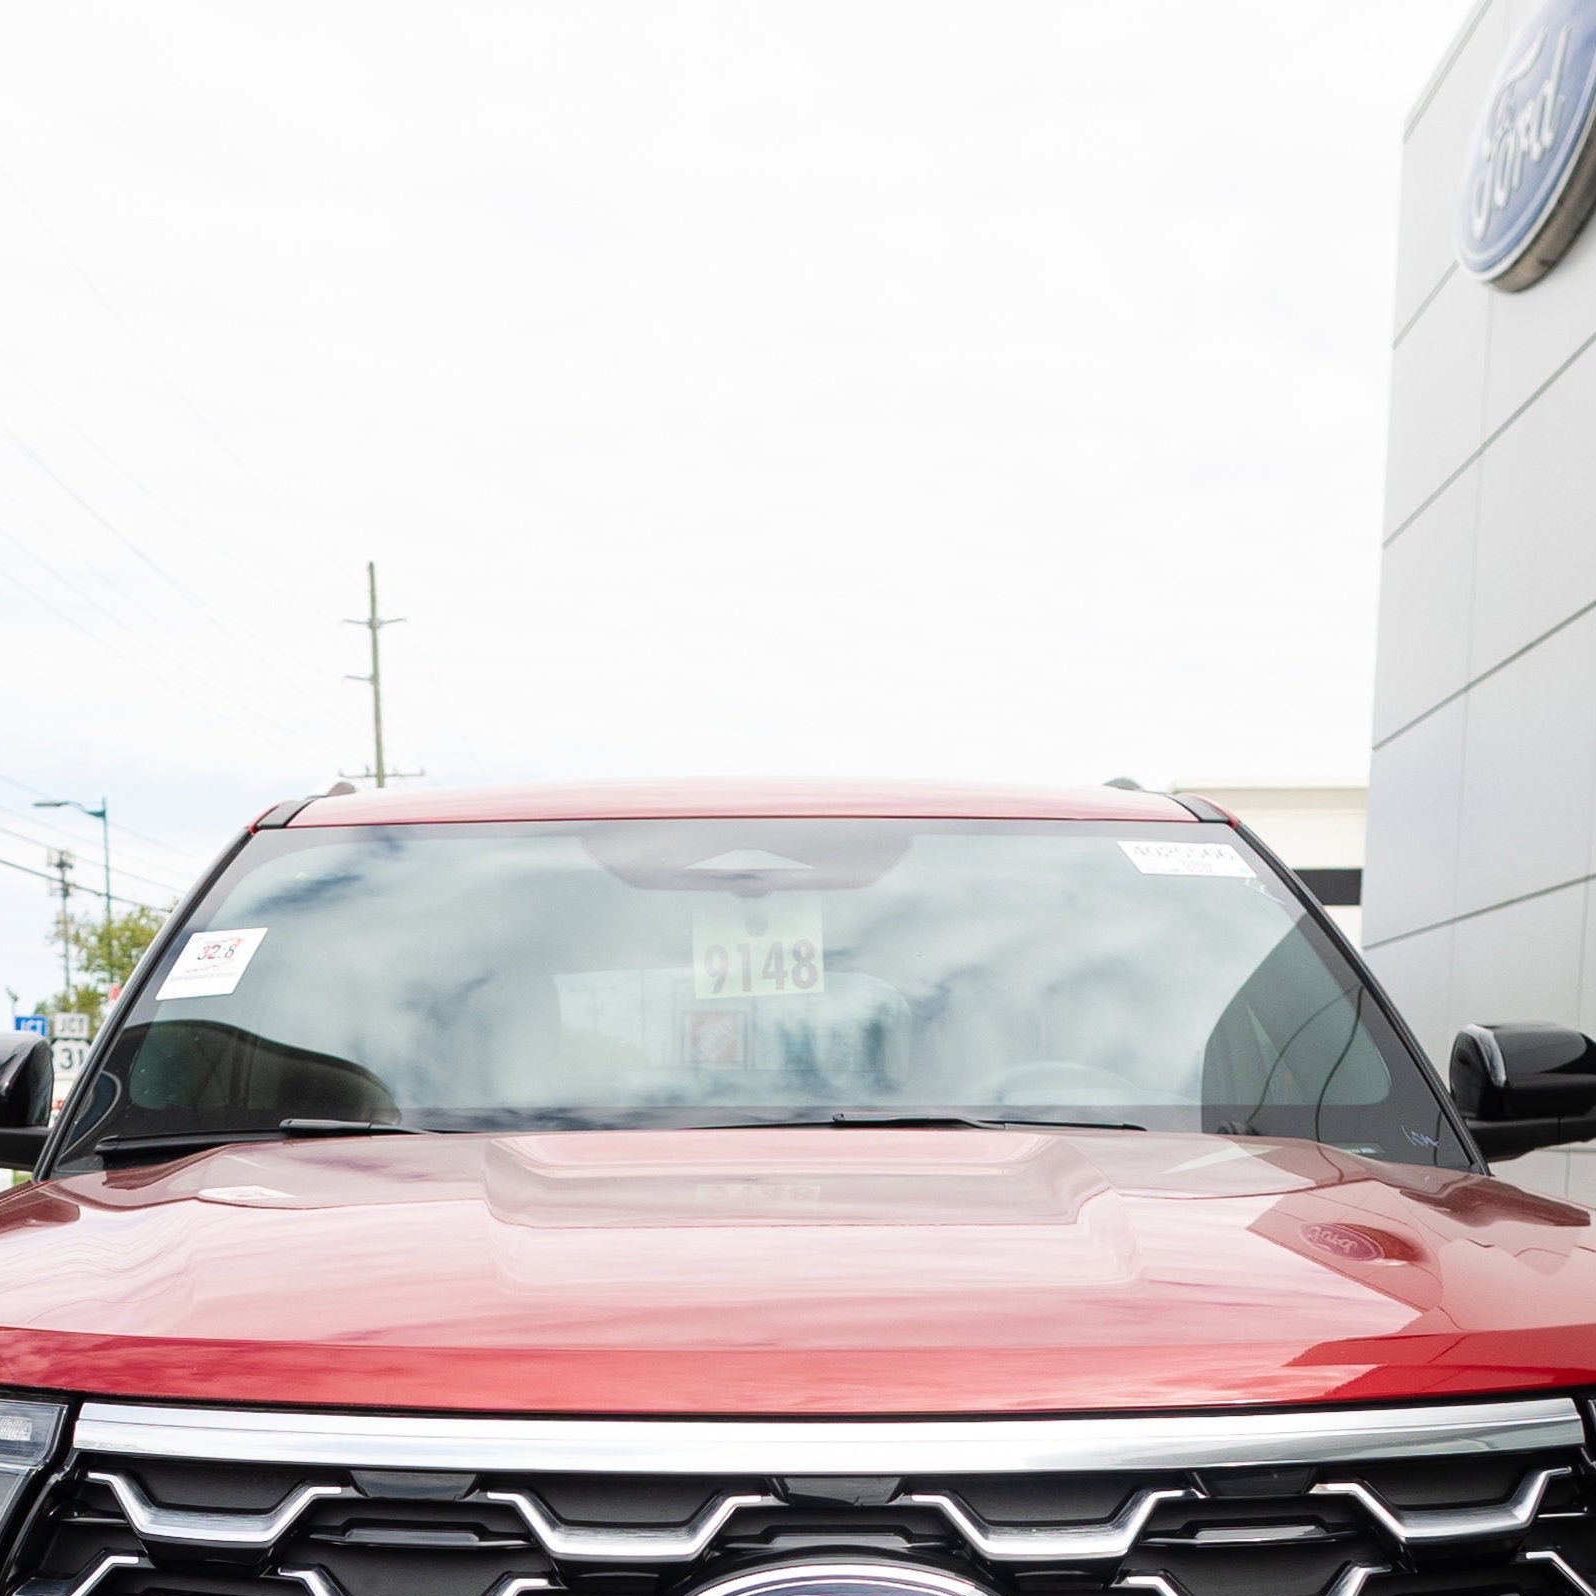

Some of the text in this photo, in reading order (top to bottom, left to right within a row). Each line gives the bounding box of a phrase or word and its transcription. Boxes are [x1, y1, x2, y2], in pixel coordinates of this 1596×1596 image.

[1471, 22, 1573, 242] Ford
[703, 939, 819, 994] 9148
[59, 1017, 86, 1033] JCT
[59, 1047, 84, 1070] 31
